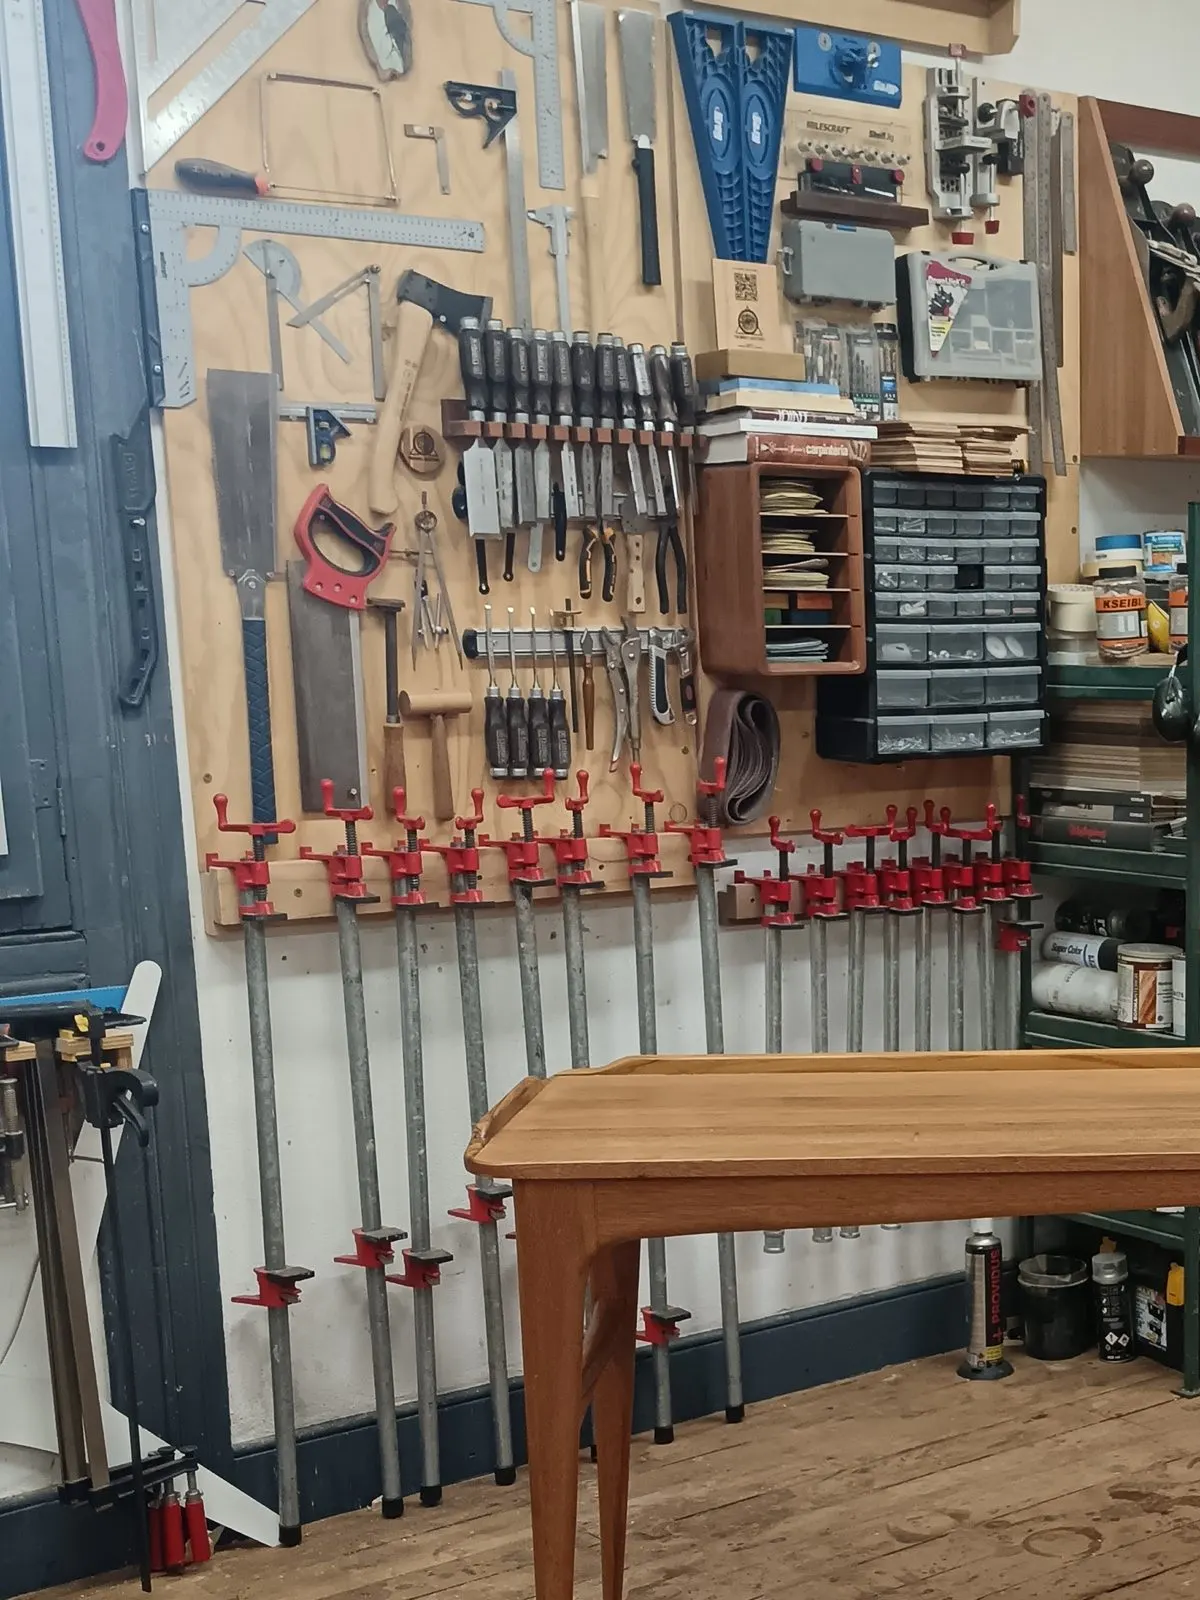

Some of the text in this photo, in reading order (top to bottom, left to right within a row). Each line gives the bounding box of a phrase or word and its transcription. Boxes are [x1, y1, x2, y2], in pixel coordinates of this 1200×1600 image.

[1051, 942, 1083, 955] Super Color
[991, 1249, 1001, 1325] PROVIDUS
